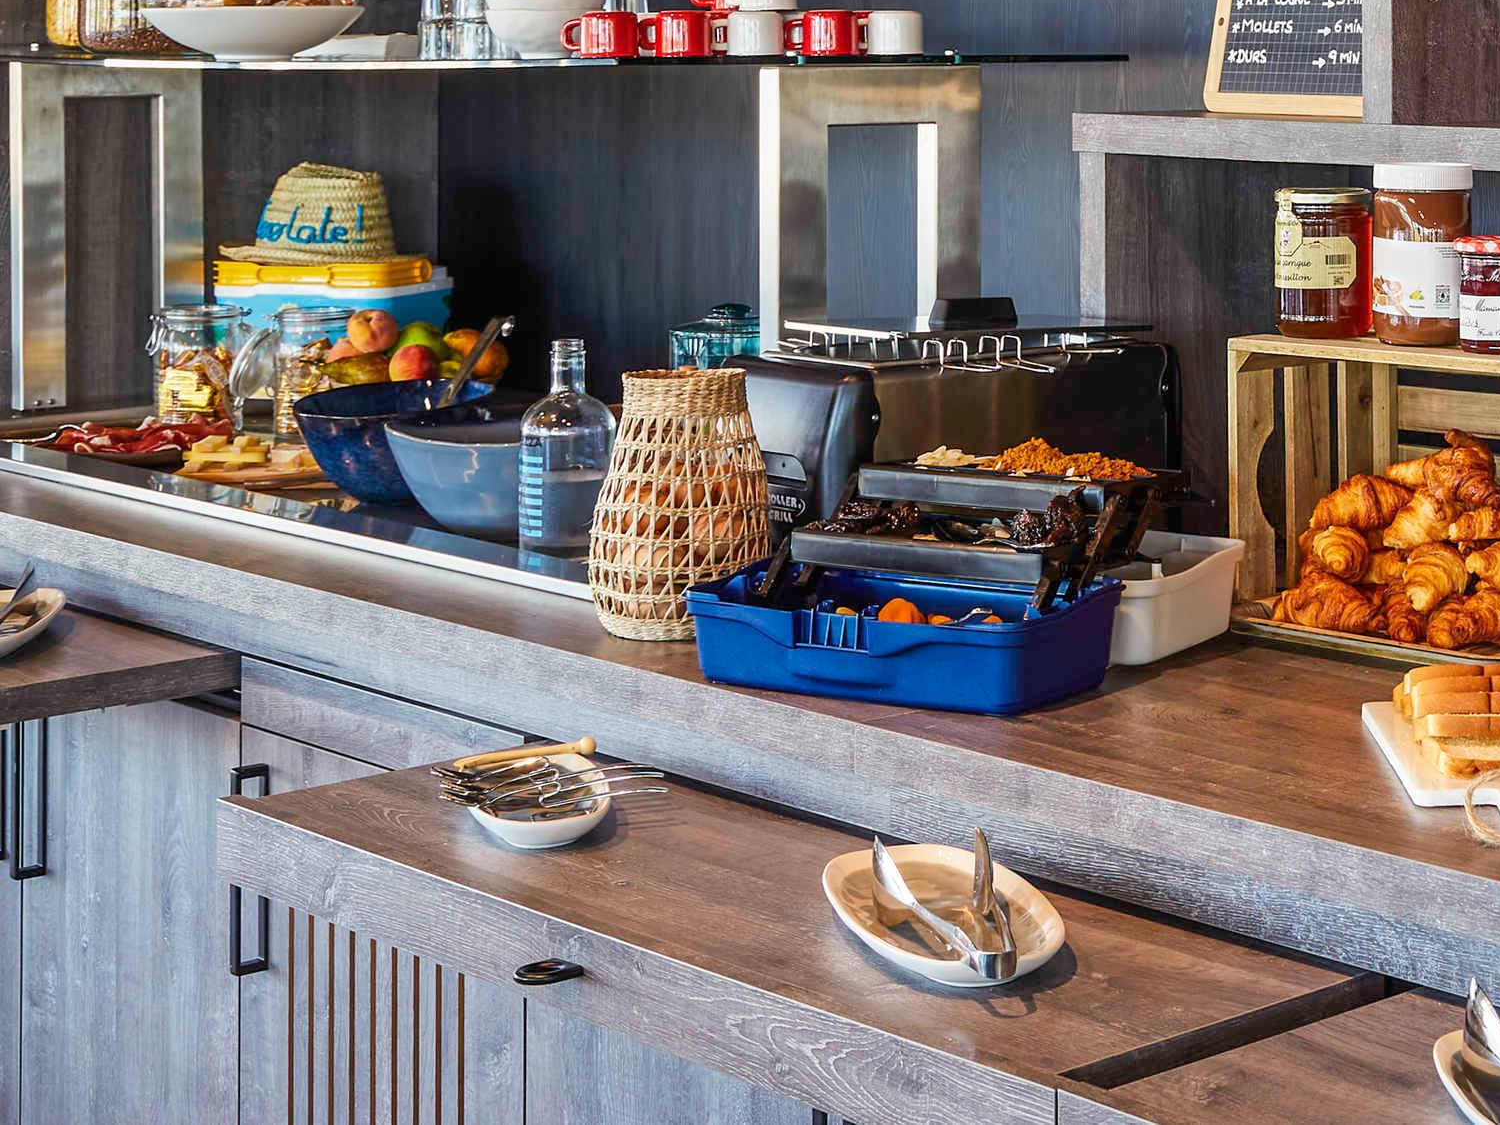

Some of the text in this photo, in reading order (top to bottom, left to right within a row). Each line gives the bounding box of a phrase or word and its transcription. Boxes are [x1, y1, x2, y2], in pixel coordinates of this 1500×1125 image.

[1334, 19, 1343, 33] 6
[1328, 49, 1338, 65] 9
[1340, 50, 1361, 65] MIN
[768, 493, 798, 509] OLLER
